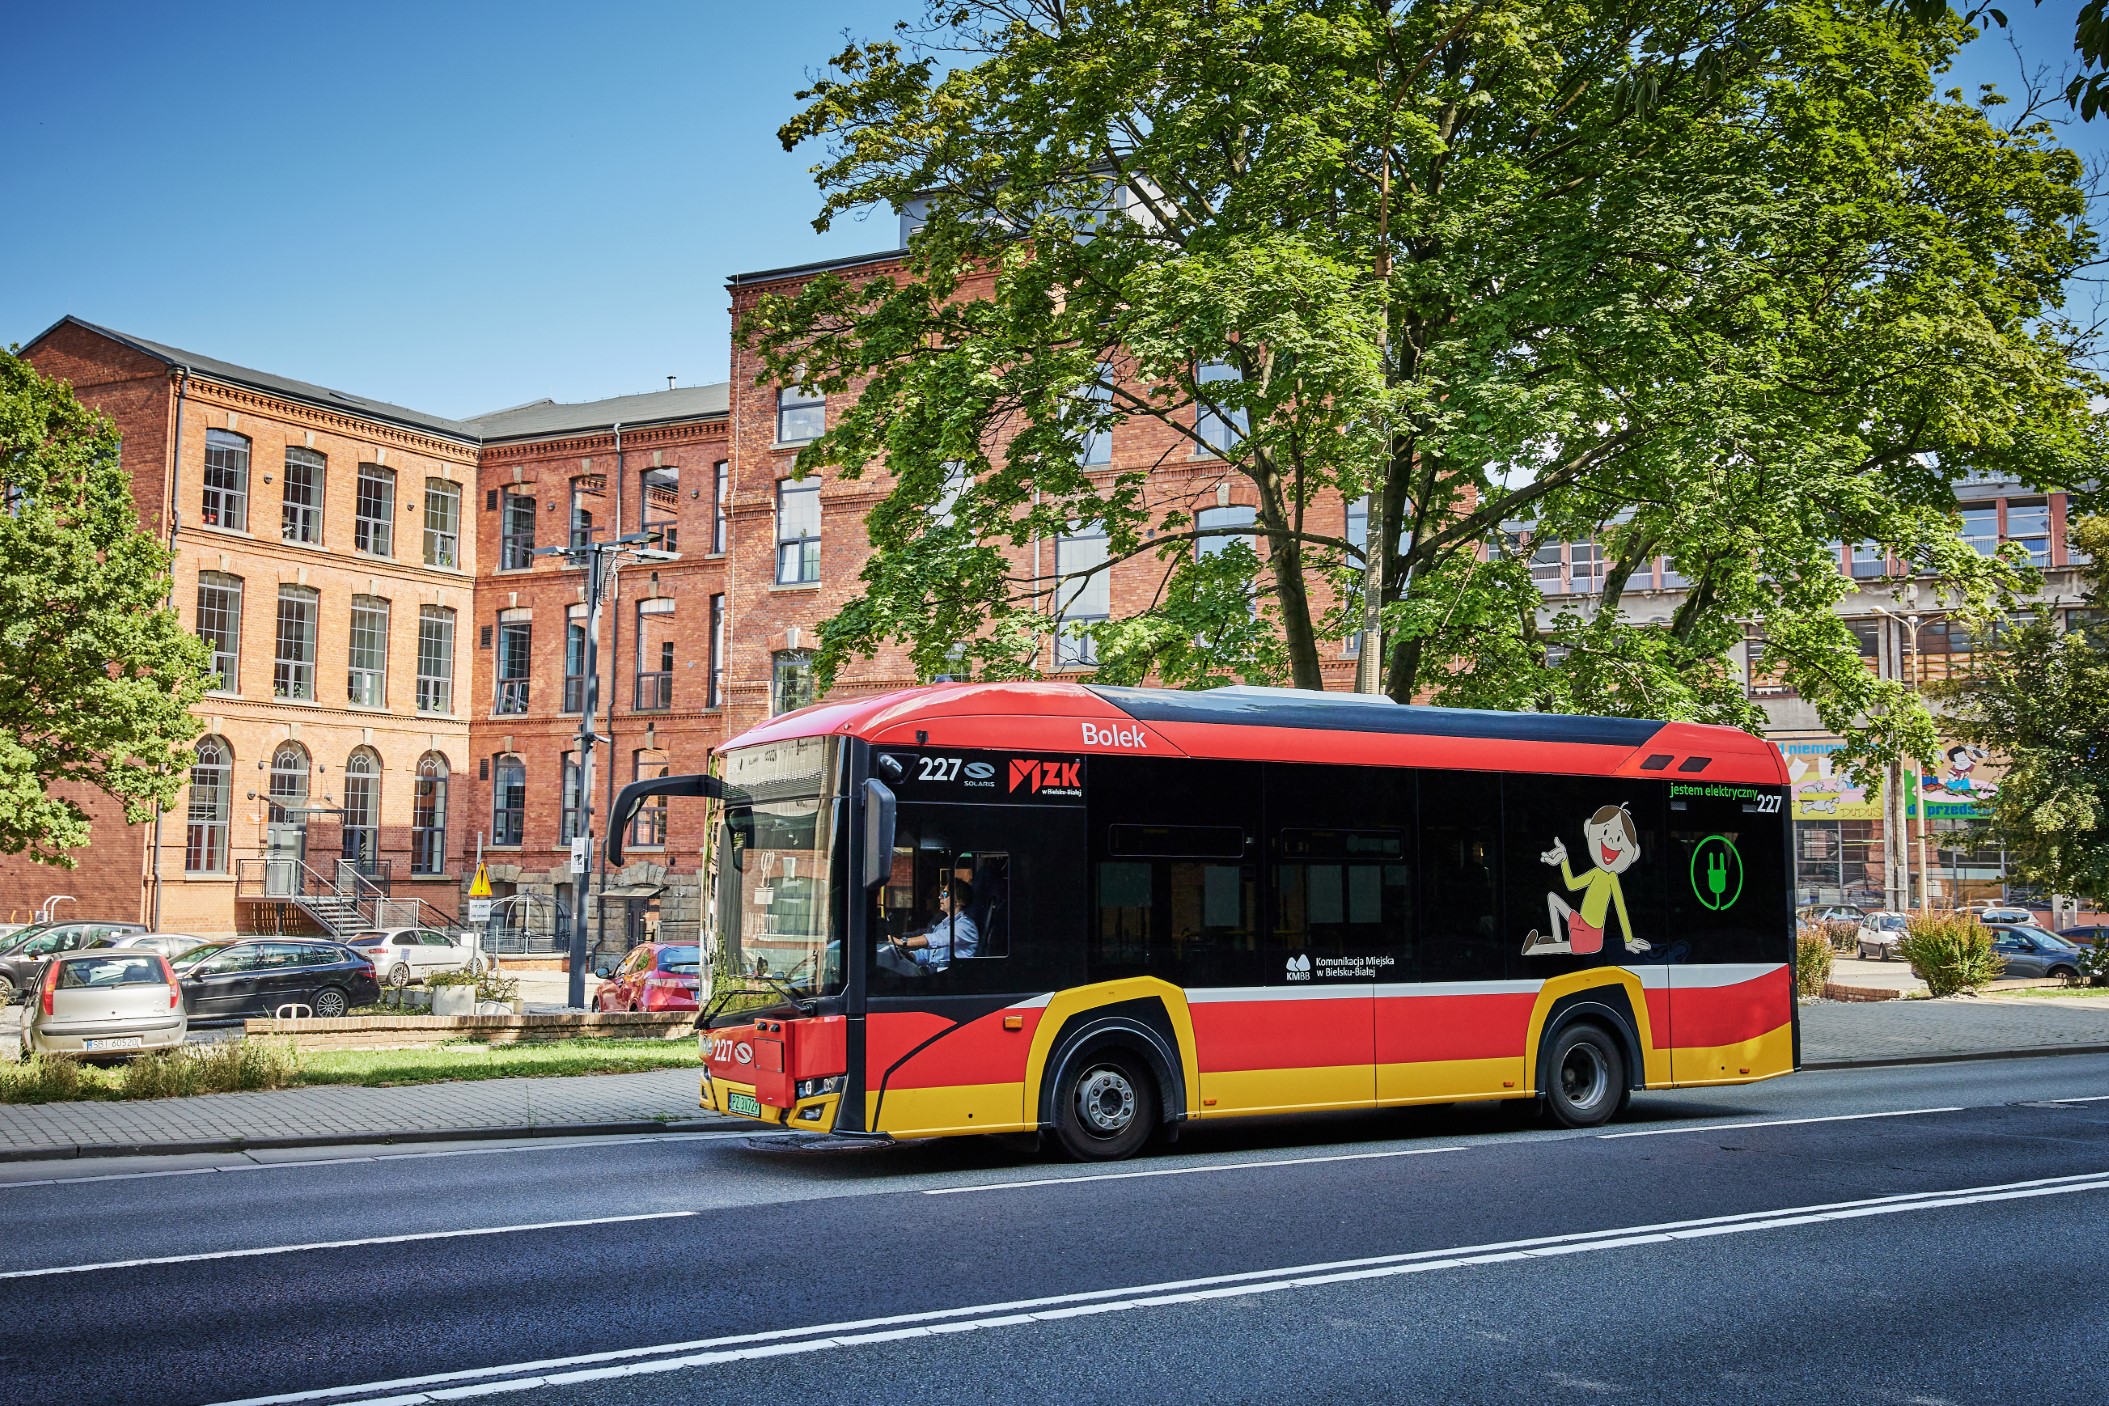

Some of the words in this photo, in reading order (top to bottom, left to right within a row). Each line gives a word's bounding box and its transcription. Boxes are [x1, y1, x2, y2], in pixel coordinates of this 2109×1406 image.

[1081, 722, 1147, 748] Bolek
[918, 757, 962, 781] 227
[1009, 759, 1081, 794] MZK
[1669, 782, 1703, 798] jestem
[1705, 784, 1758, 801] elektryczny
[1756, 794, 1782, 813] 227
[1316, 957, 1364, 967] Komunikacja
[1365, 956, 1395, 967] Miejska
[1286, 971, 1311, 981] KMBB
[1325, 966, 1376, 977] Bielsku-Białej
[714, 1039, 733, 1062] 227
